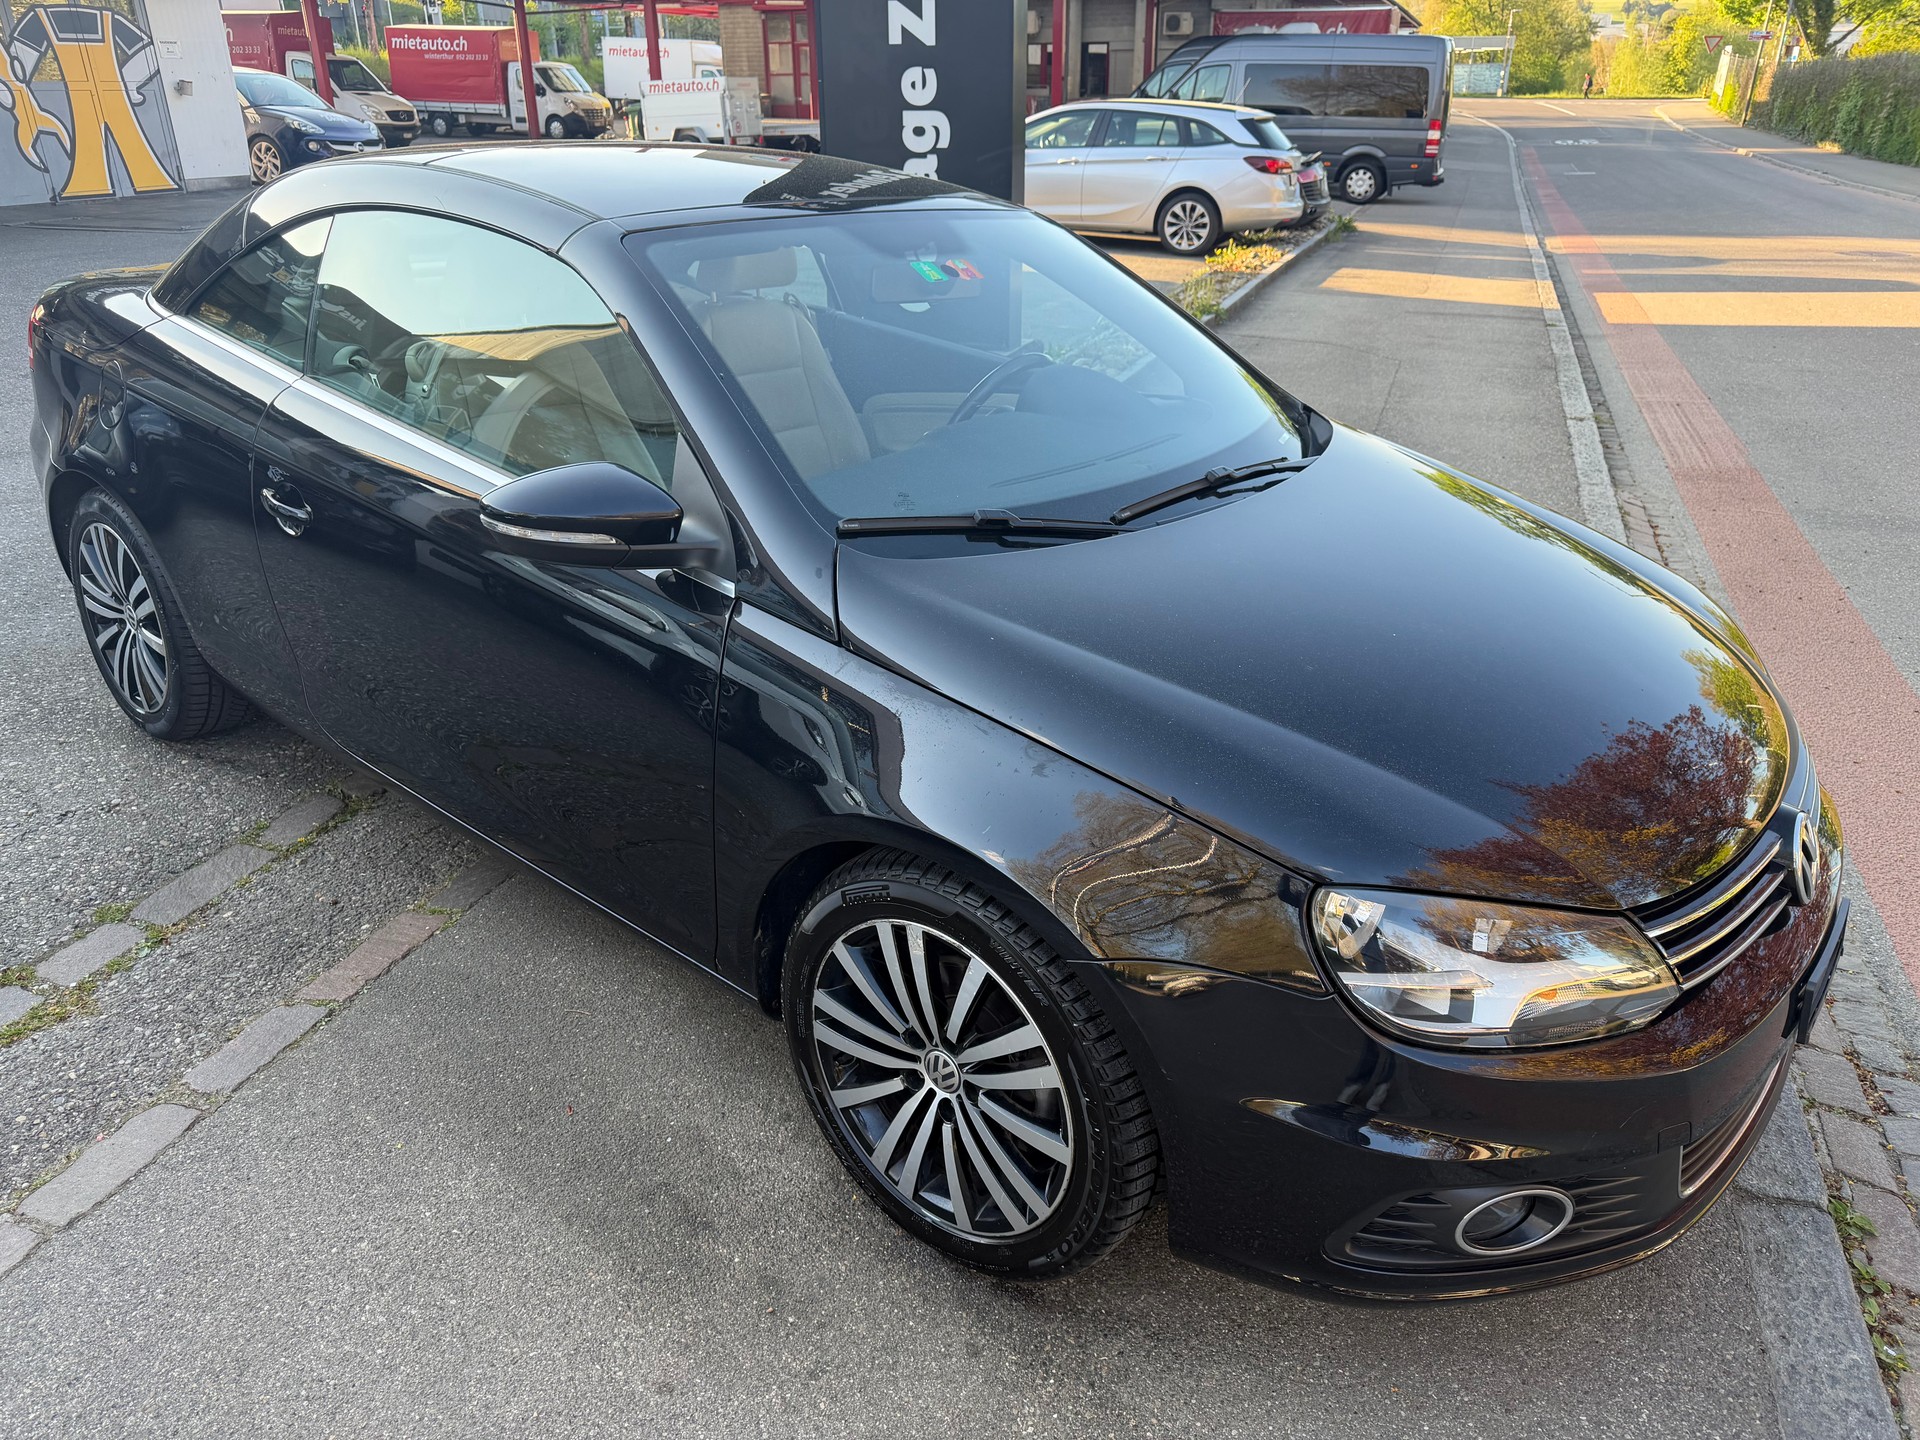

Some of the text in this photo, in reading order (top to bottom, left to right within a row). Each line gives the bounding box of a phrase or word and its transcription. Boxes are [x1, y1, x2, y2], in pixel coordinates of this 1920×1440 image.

[277, 25, 306, 37] mietaut
[232, 46, 243, 54] 202
[245, 46, 252, 54] 33
[253, 46, 261, 54] 33
[391, 34, 468, 52] mietauto.ch
[424, 52, 454, 60] winterthur
[608, 45, 670, 59] mietauch
[649, 78, 720, 93] mietauto.ch
[901, 66, 951, 181] age
